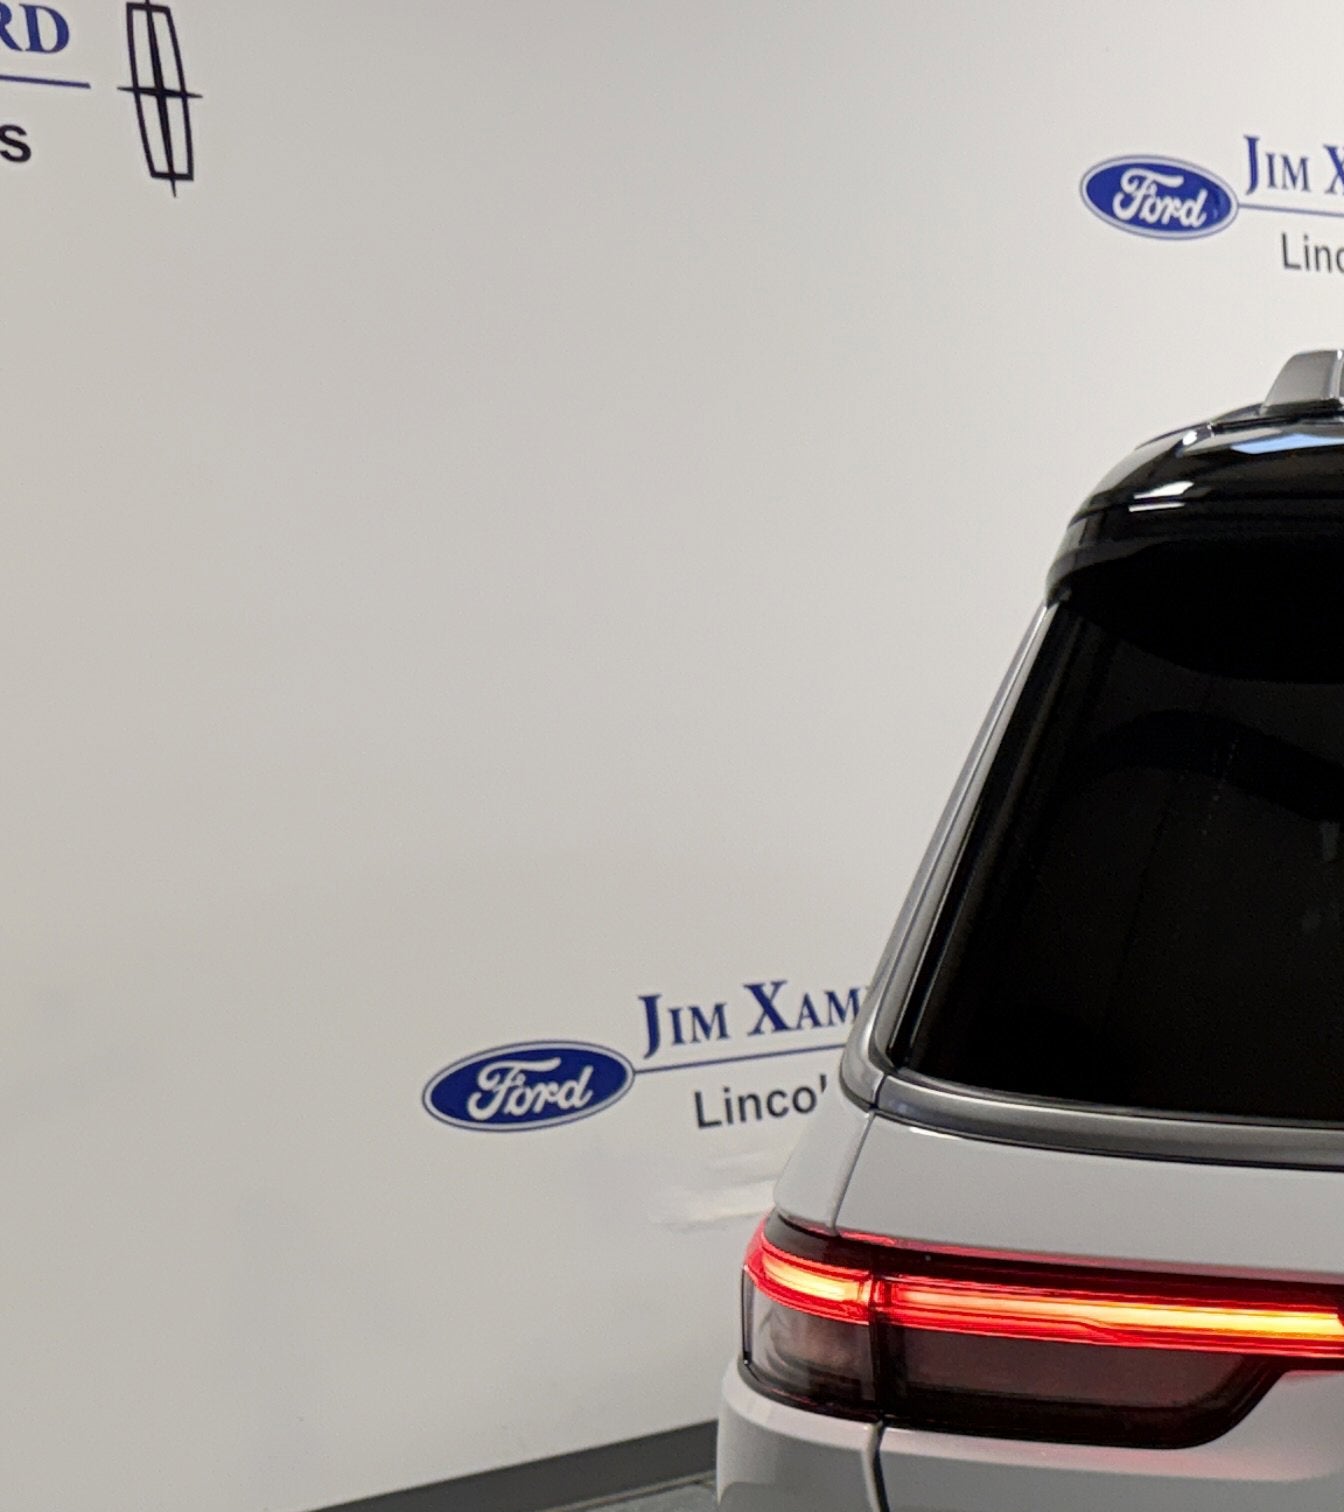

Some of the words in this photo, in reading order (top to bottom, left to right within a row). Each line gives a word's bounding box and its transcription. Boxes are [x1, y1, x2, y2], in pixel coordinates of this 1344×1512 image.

[1243, 135, 1310, 195] JIM
[1112, 168, 1208, 228] Ford
[638, 993, 730, 1060] JIM
[743, 979, 866, 1037] XAM
[467, 1056, 593, 1121] Ford
